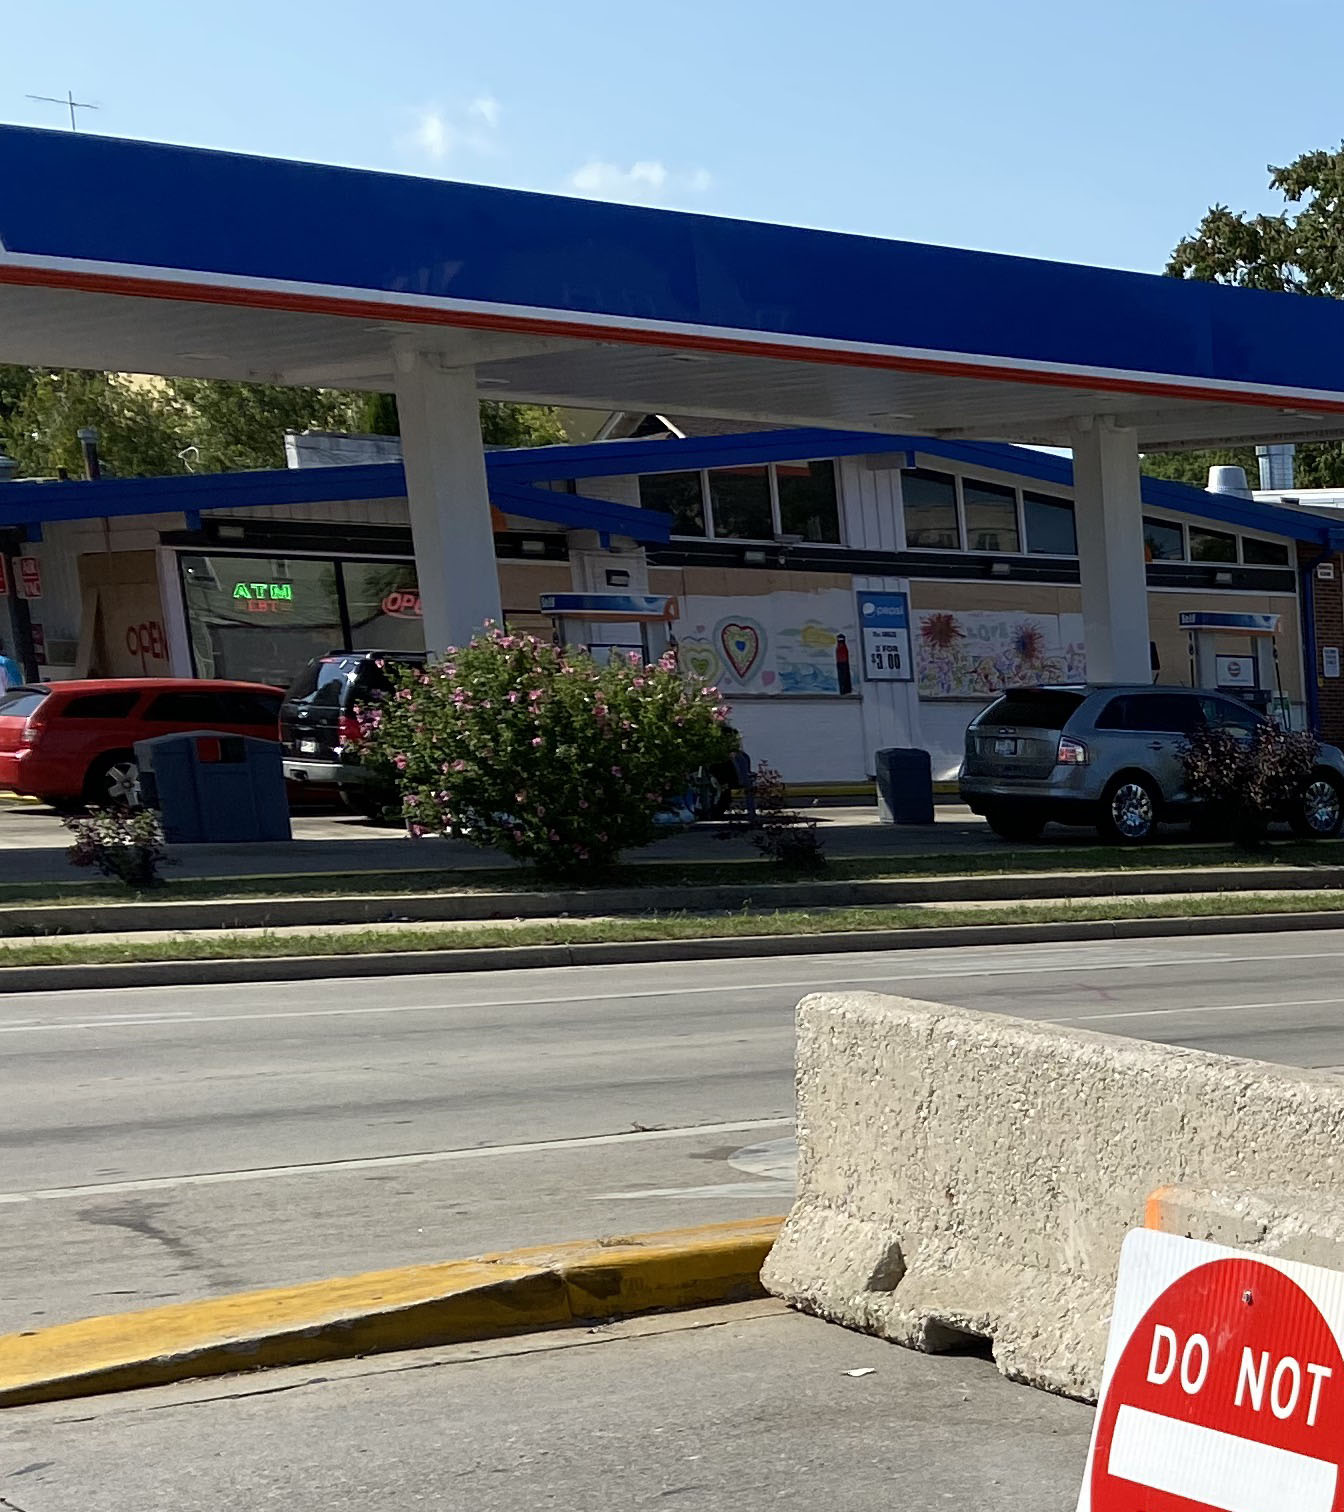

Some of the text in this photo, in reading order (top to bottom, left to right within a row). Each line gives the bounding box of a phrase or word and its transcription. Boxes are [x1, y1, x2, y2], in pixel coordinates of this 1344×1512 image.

[233, 583, 292, 600] ATM
[882, 645, 899, 653] FOR
[1147, 1323, 1332, 1427] DO NOT
